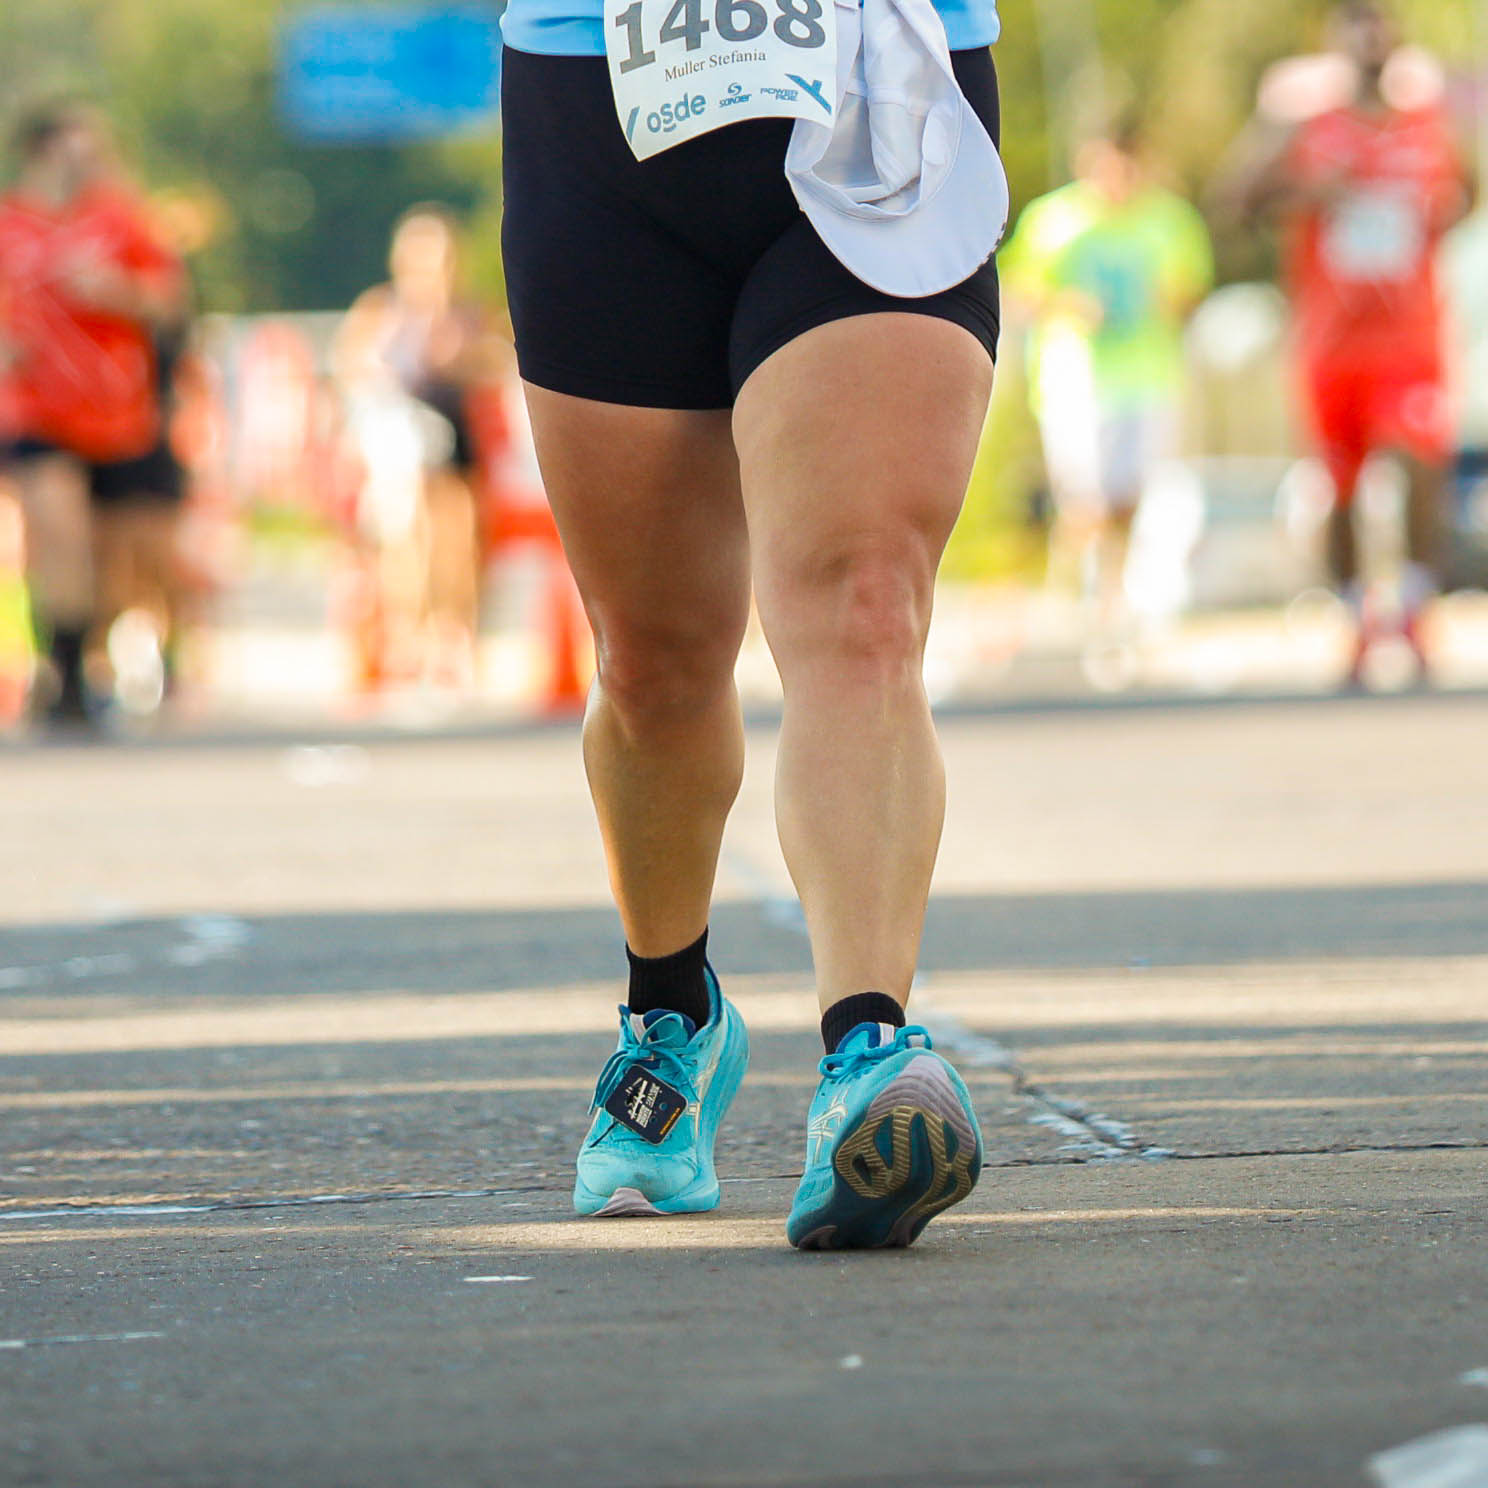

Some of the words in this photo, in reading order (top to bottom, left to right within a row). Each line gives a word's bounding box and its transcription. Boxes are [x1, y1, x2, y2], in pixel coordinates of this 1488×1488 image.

[664, 62, 705, 82] Muller
[709, 49, 767, 69] Stefania
[646, 92, 707, 134] osde
